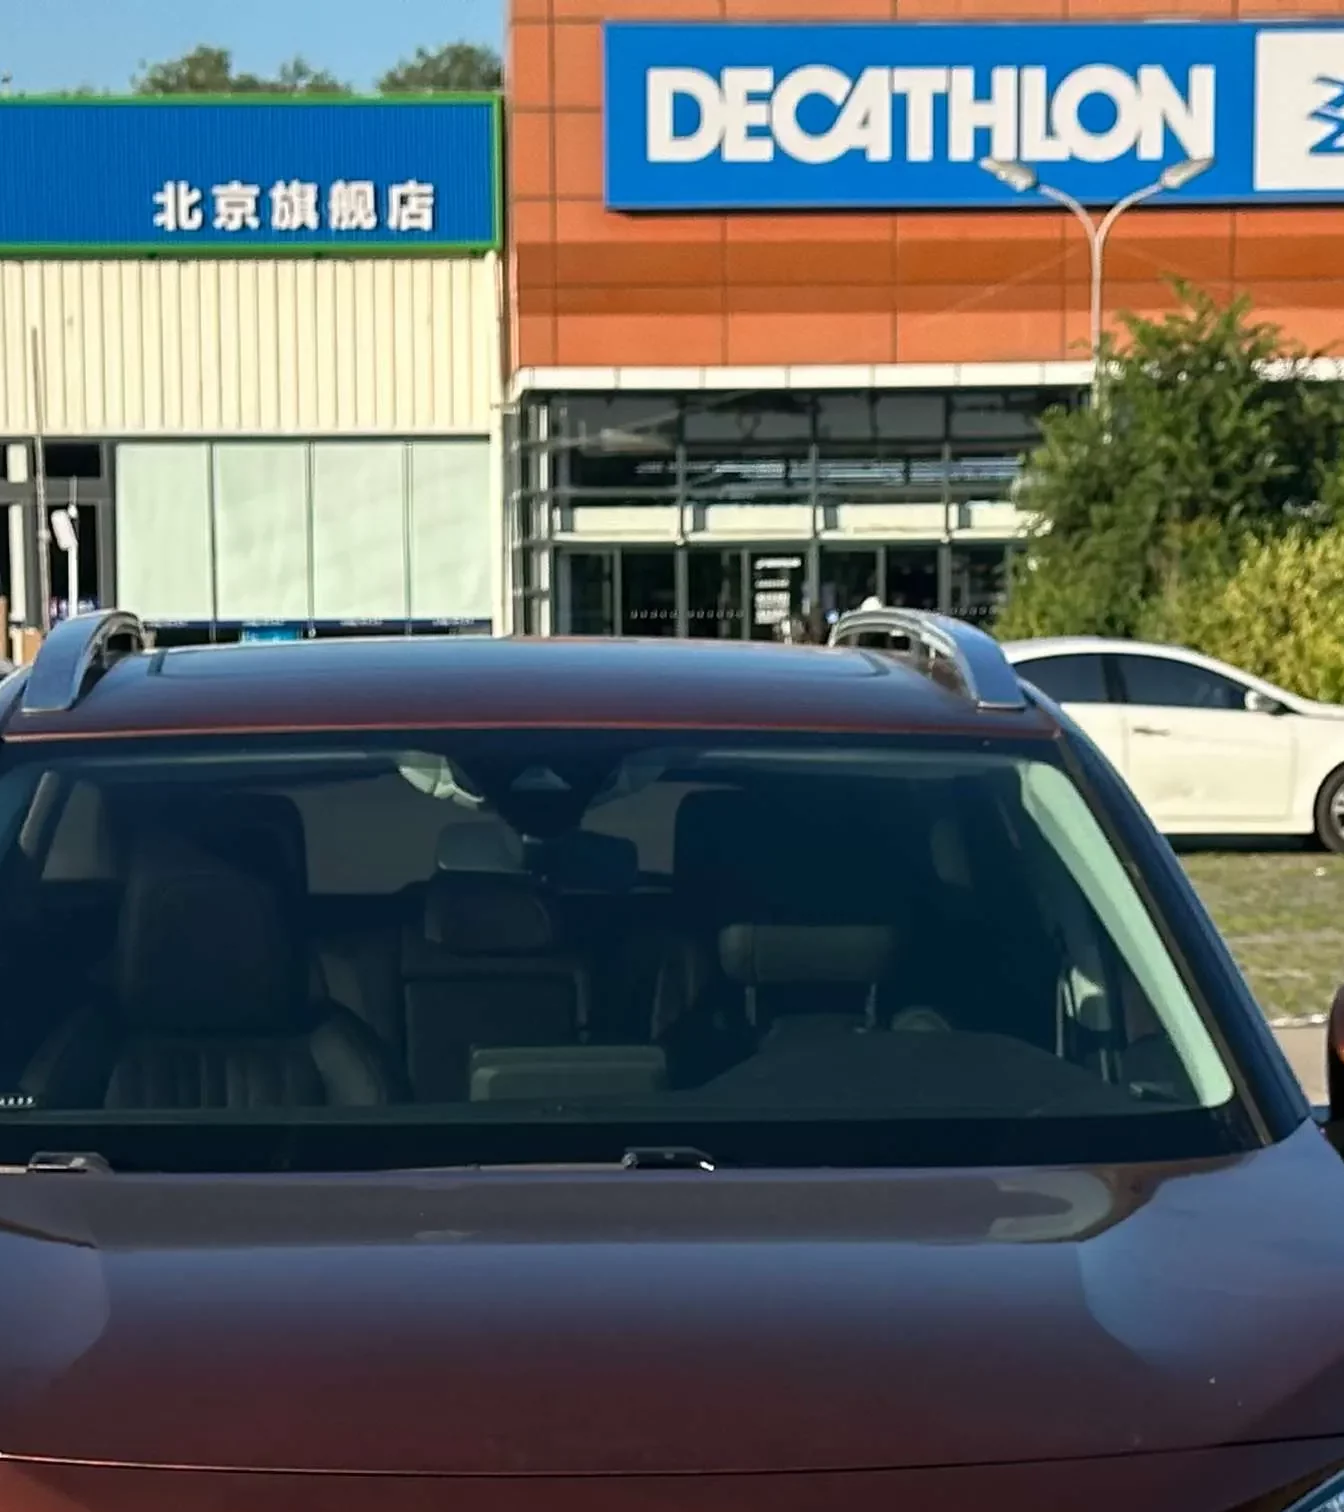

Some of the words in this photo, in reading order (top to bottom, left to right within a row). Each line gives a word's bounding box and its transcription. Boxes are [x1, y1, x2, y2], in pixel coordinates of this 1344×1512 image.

[646, 63, 1216, 164] DECATHLON
[153, 180, 437, 232] 北京旗舰店
